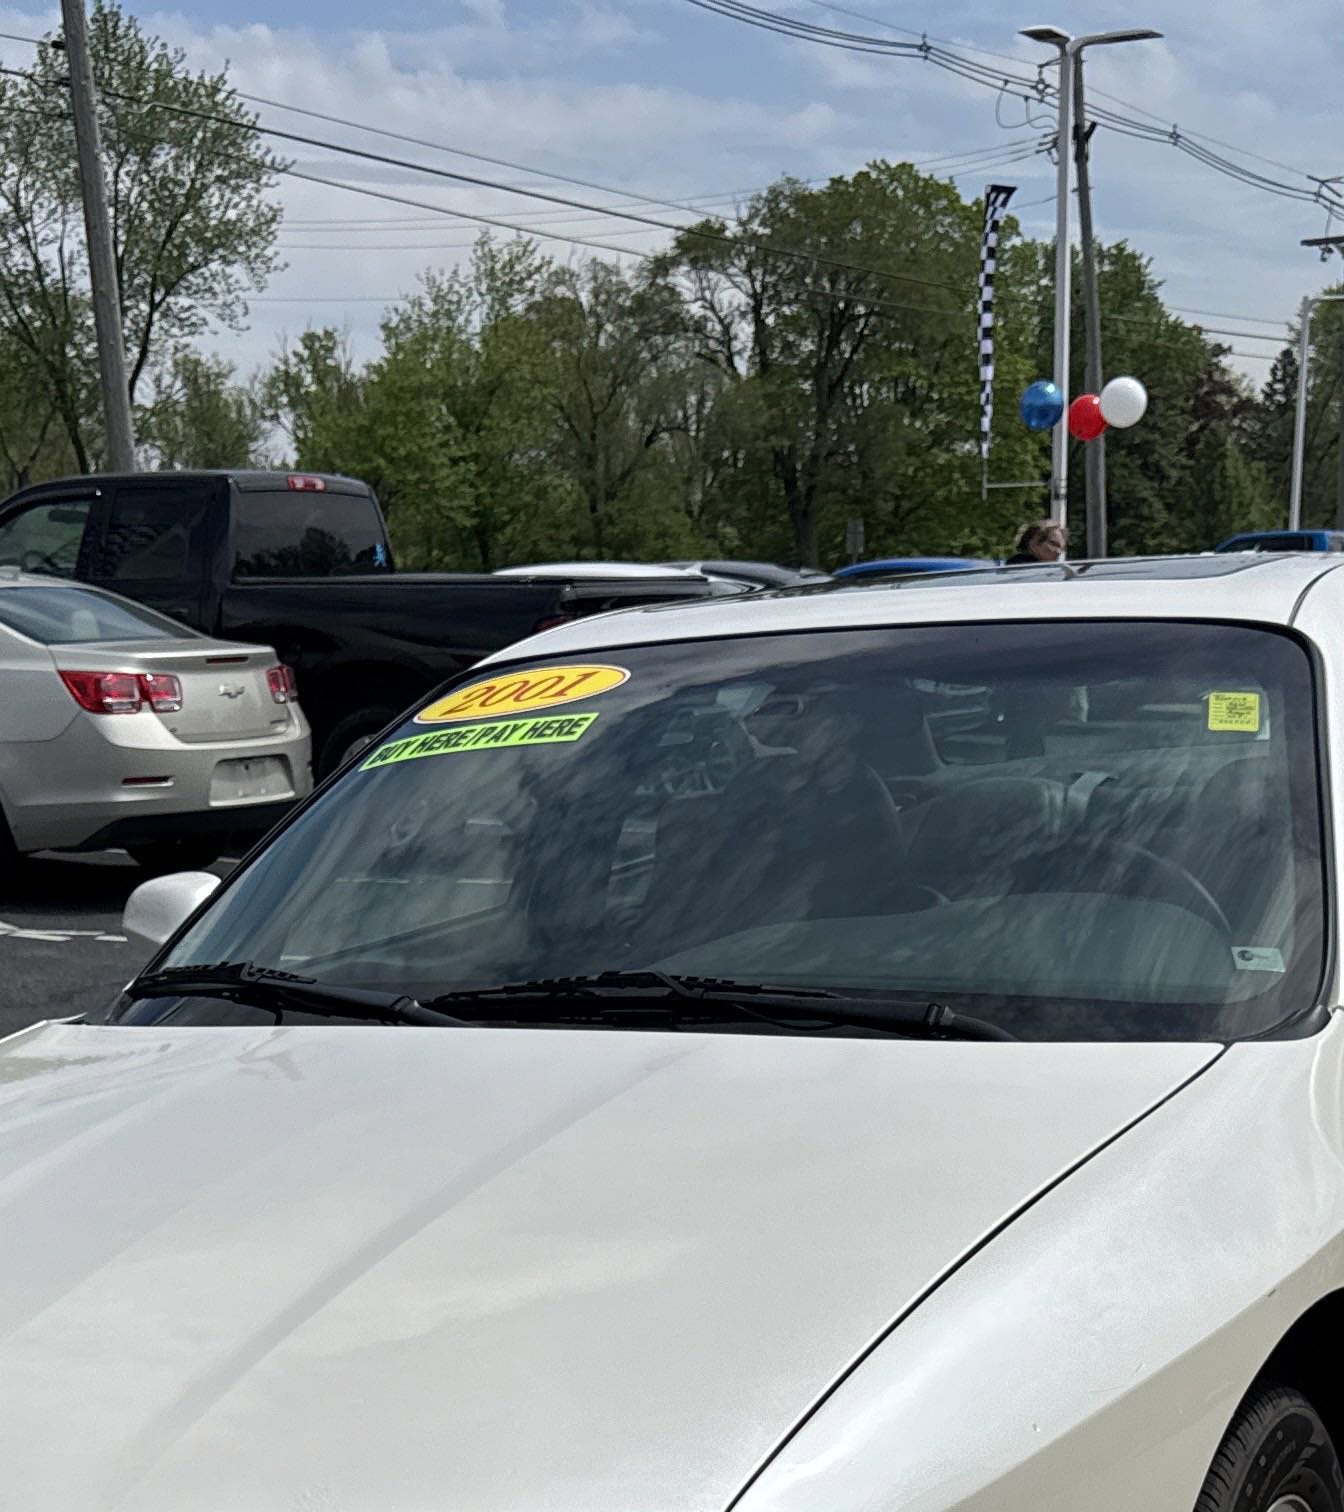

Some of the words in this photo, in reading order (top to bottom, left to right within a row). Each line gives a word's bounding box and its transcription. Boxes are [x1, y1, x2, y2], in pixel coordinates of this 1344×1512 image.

[439, 670, 600, 717] 2001
[367, 743, 419, 766] BUY
[416, 722, 524, 755] HERE/PAY
[520, 716, 591, 741] HERE
